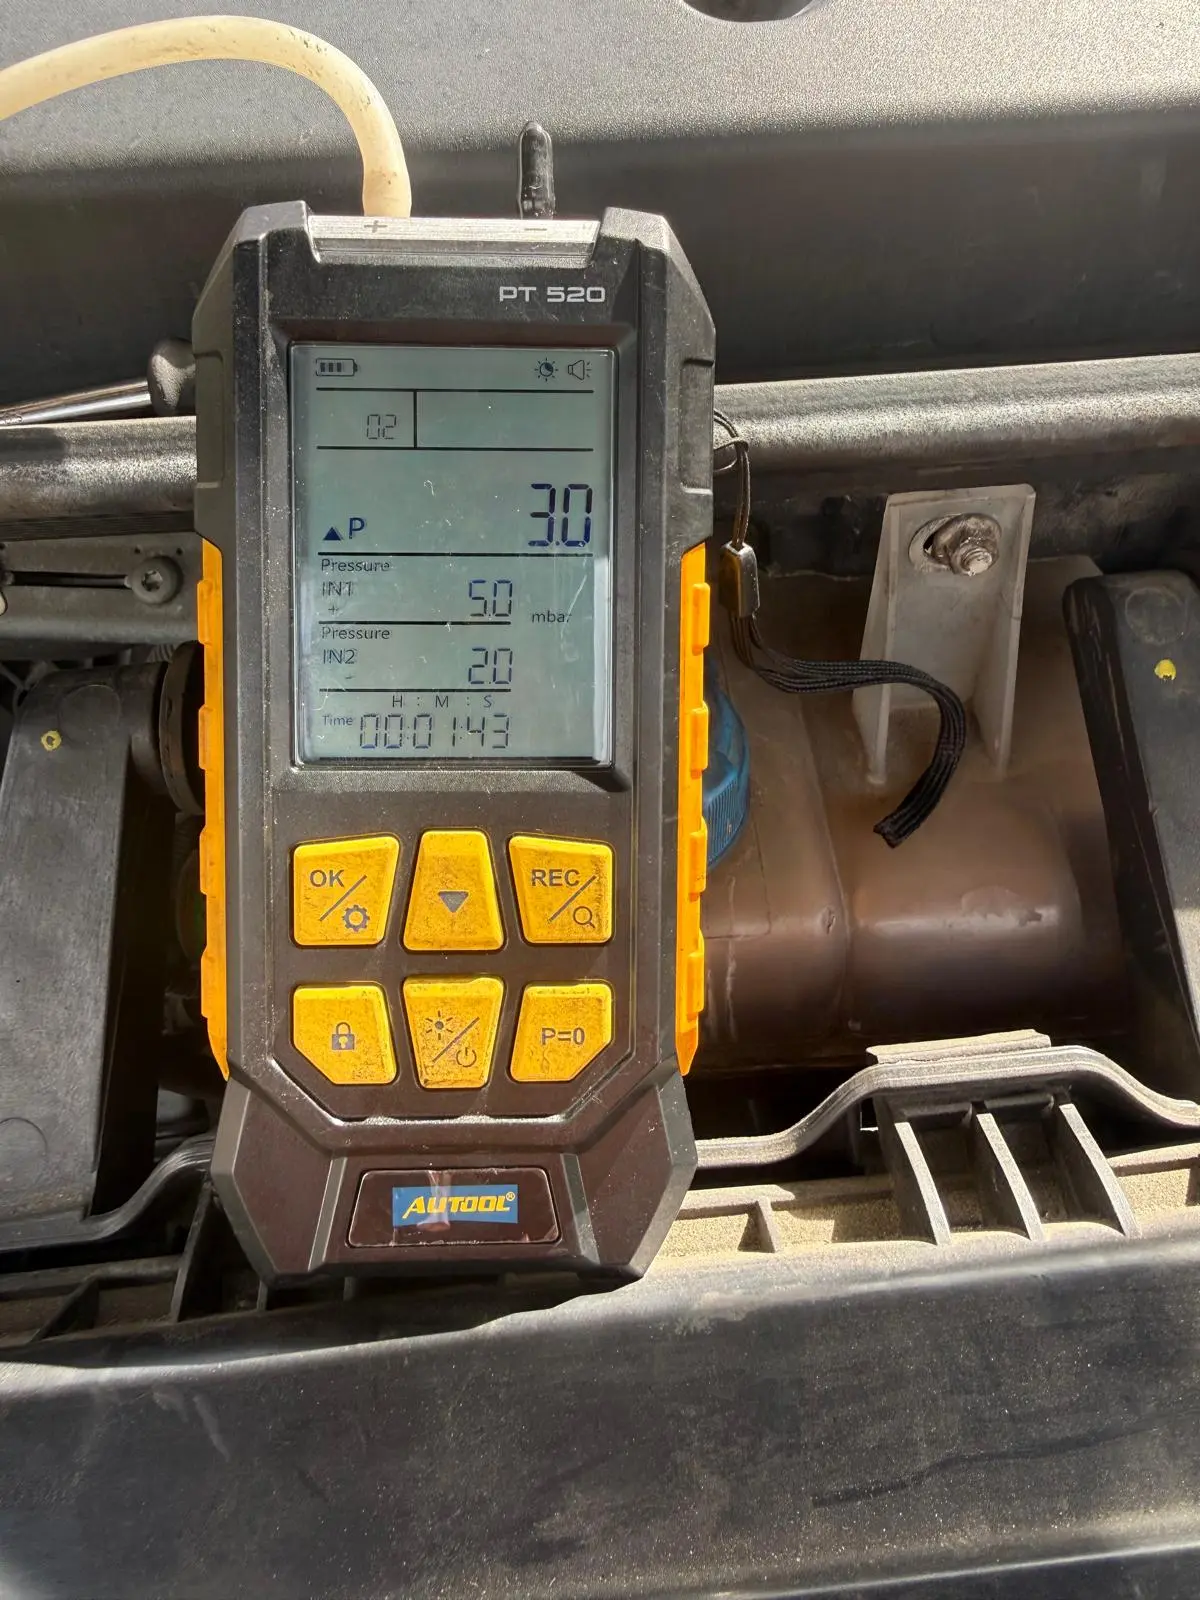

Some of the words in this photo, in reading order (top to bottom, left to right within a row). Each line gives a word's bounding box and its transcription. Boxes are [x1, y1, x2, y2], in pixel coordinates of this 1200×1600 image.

[499, 286, 537, 303] PT
[546, 286, 606, 303] 520
[366, 414, 397, 440] 02
[528, 483, 593, 547] 3.0
[348, 517, 366, 540] P
[320, 559, 391, 573] Pressure
[321, 581, 354, 597] IN1
[468, 580, 513, 617] 5.0
[321, 626, 391, 641] Pressure
[322, 649, 356, 665] IN2
[468, 648, 513, 685] 2.0
[321, 715, 354, 727] Time
[309, 869, 345, 888] OK
[531, 869, 580, 887] REC
[541, 1027, 586, 1046] P=0
